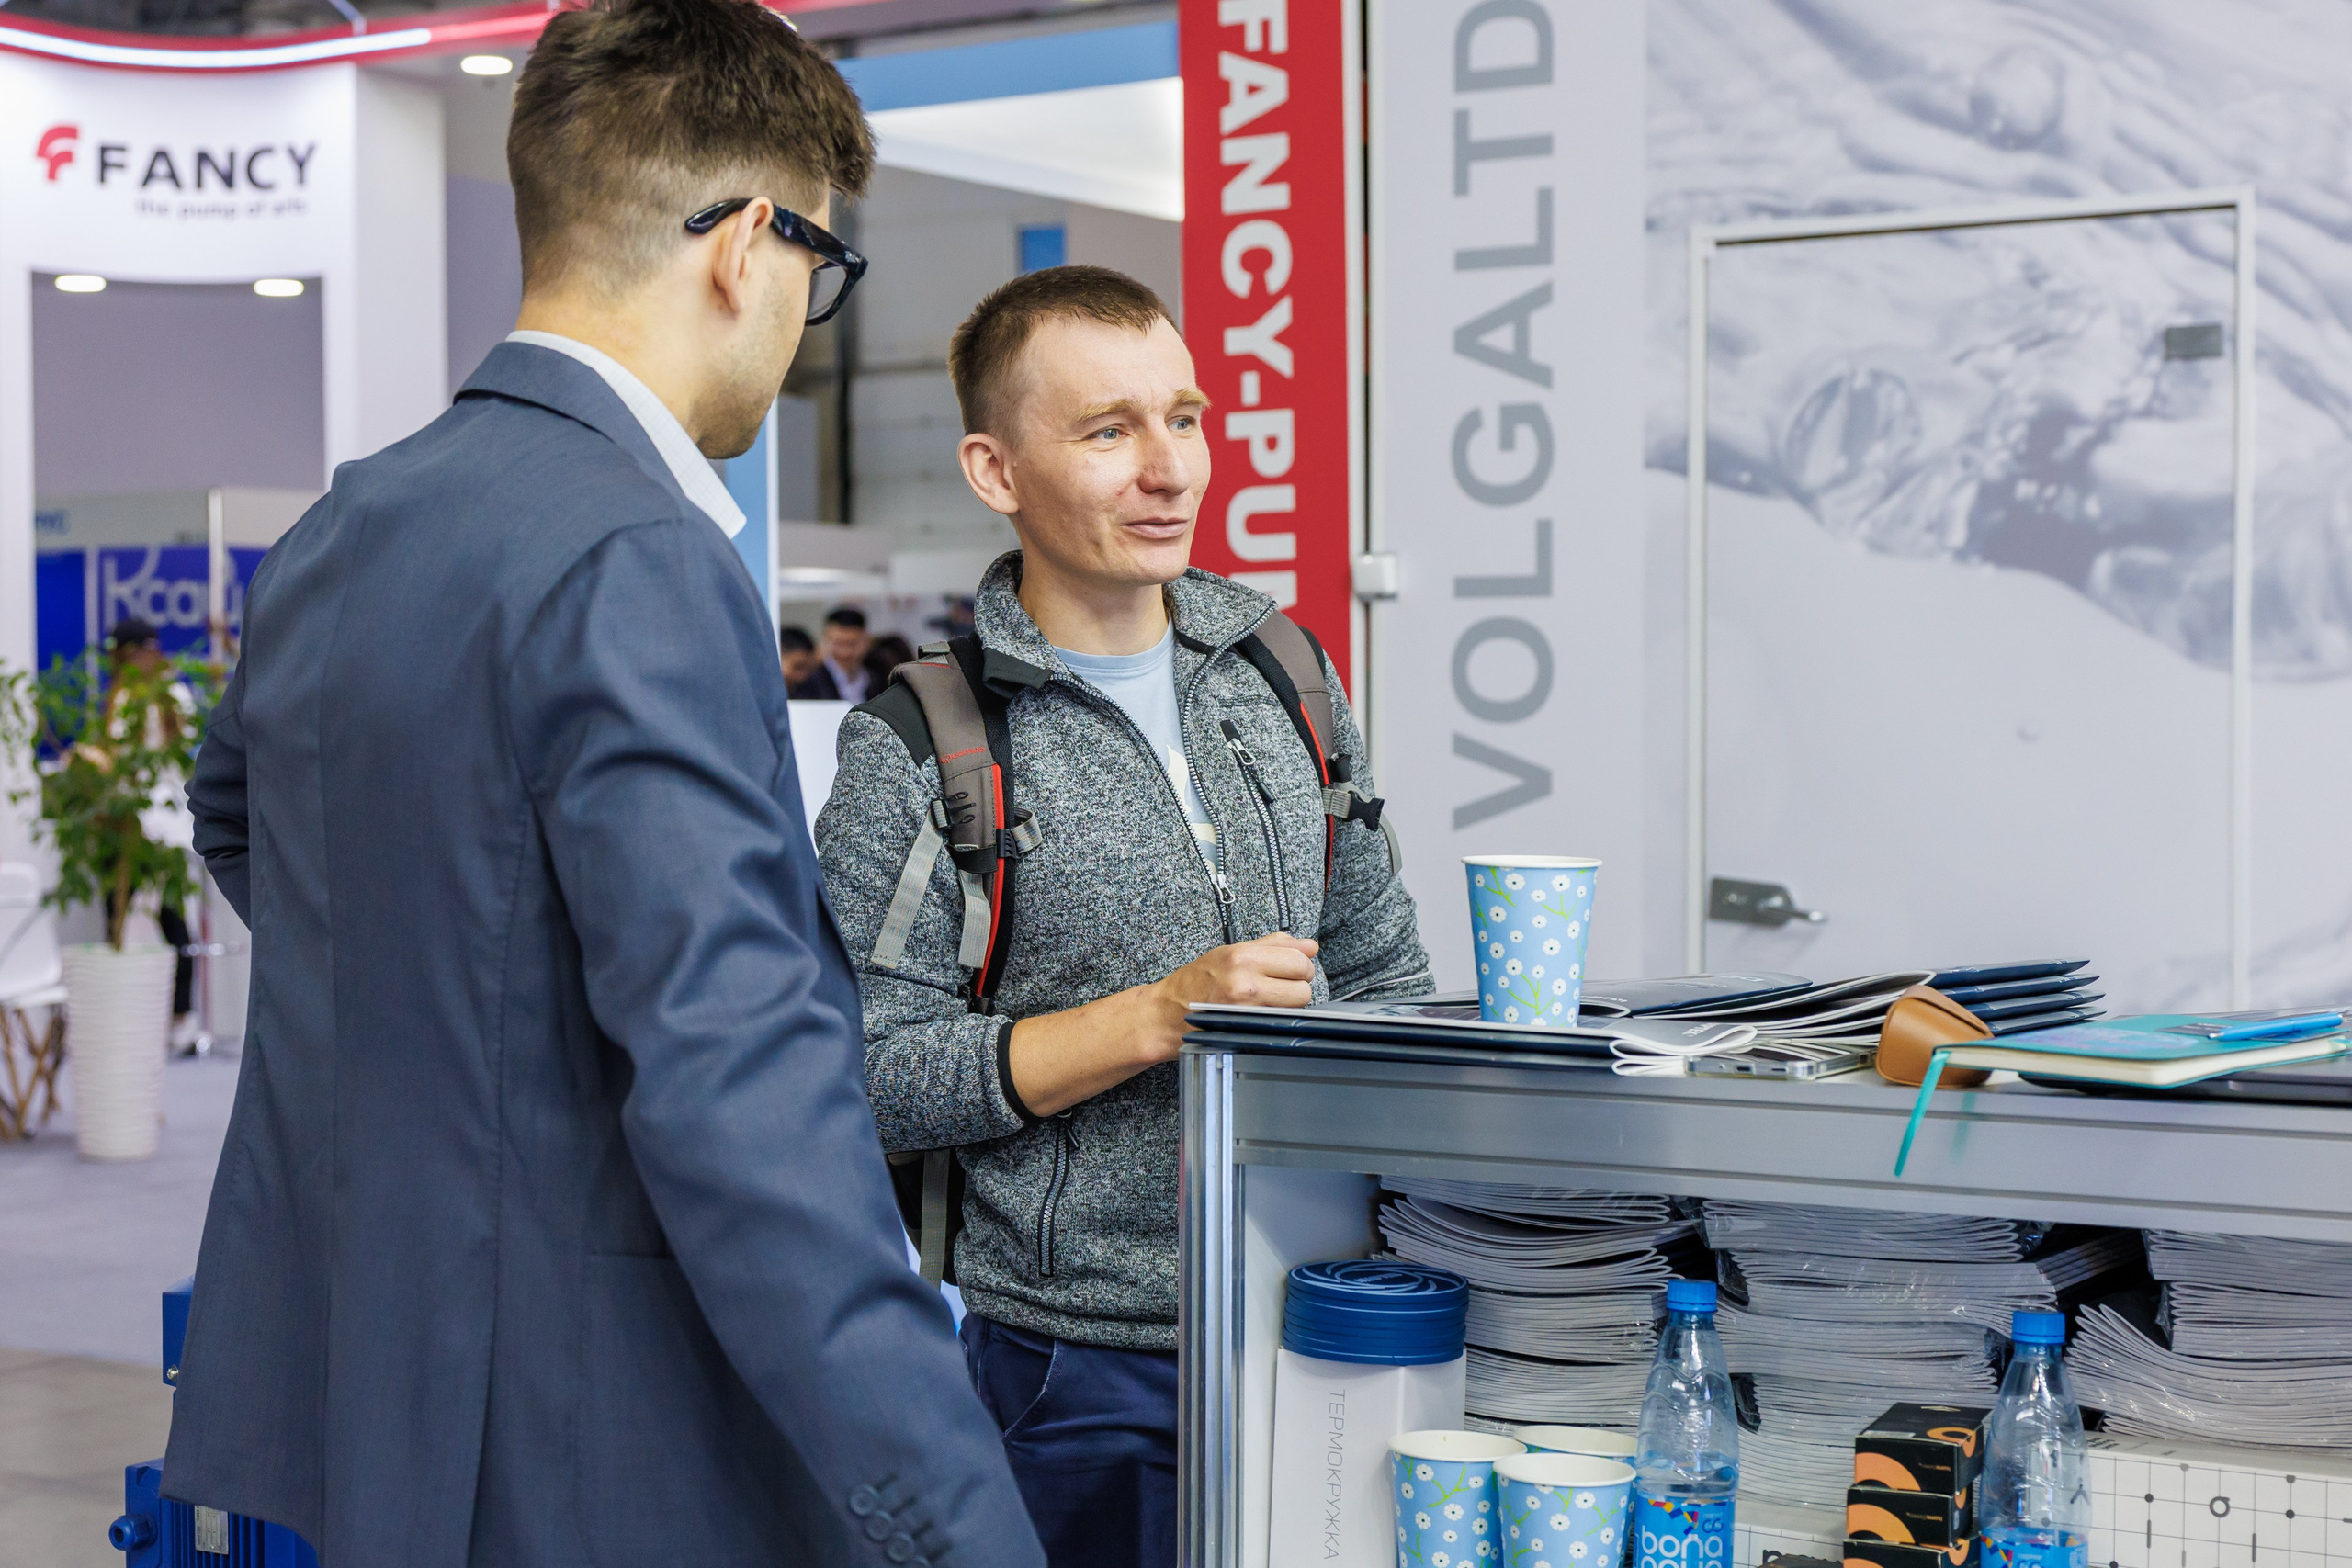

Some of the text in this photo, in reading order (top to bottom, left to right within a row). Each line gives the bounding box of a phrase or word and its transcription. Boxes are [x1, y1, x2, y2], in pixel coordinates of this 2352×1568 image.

[99, 144, 315, 189] FANCY
[1452, 0, 1555, 831] VOLGALTD
[1323, 1389, 1346, 1560] ТЕРМОКРУЖКА
